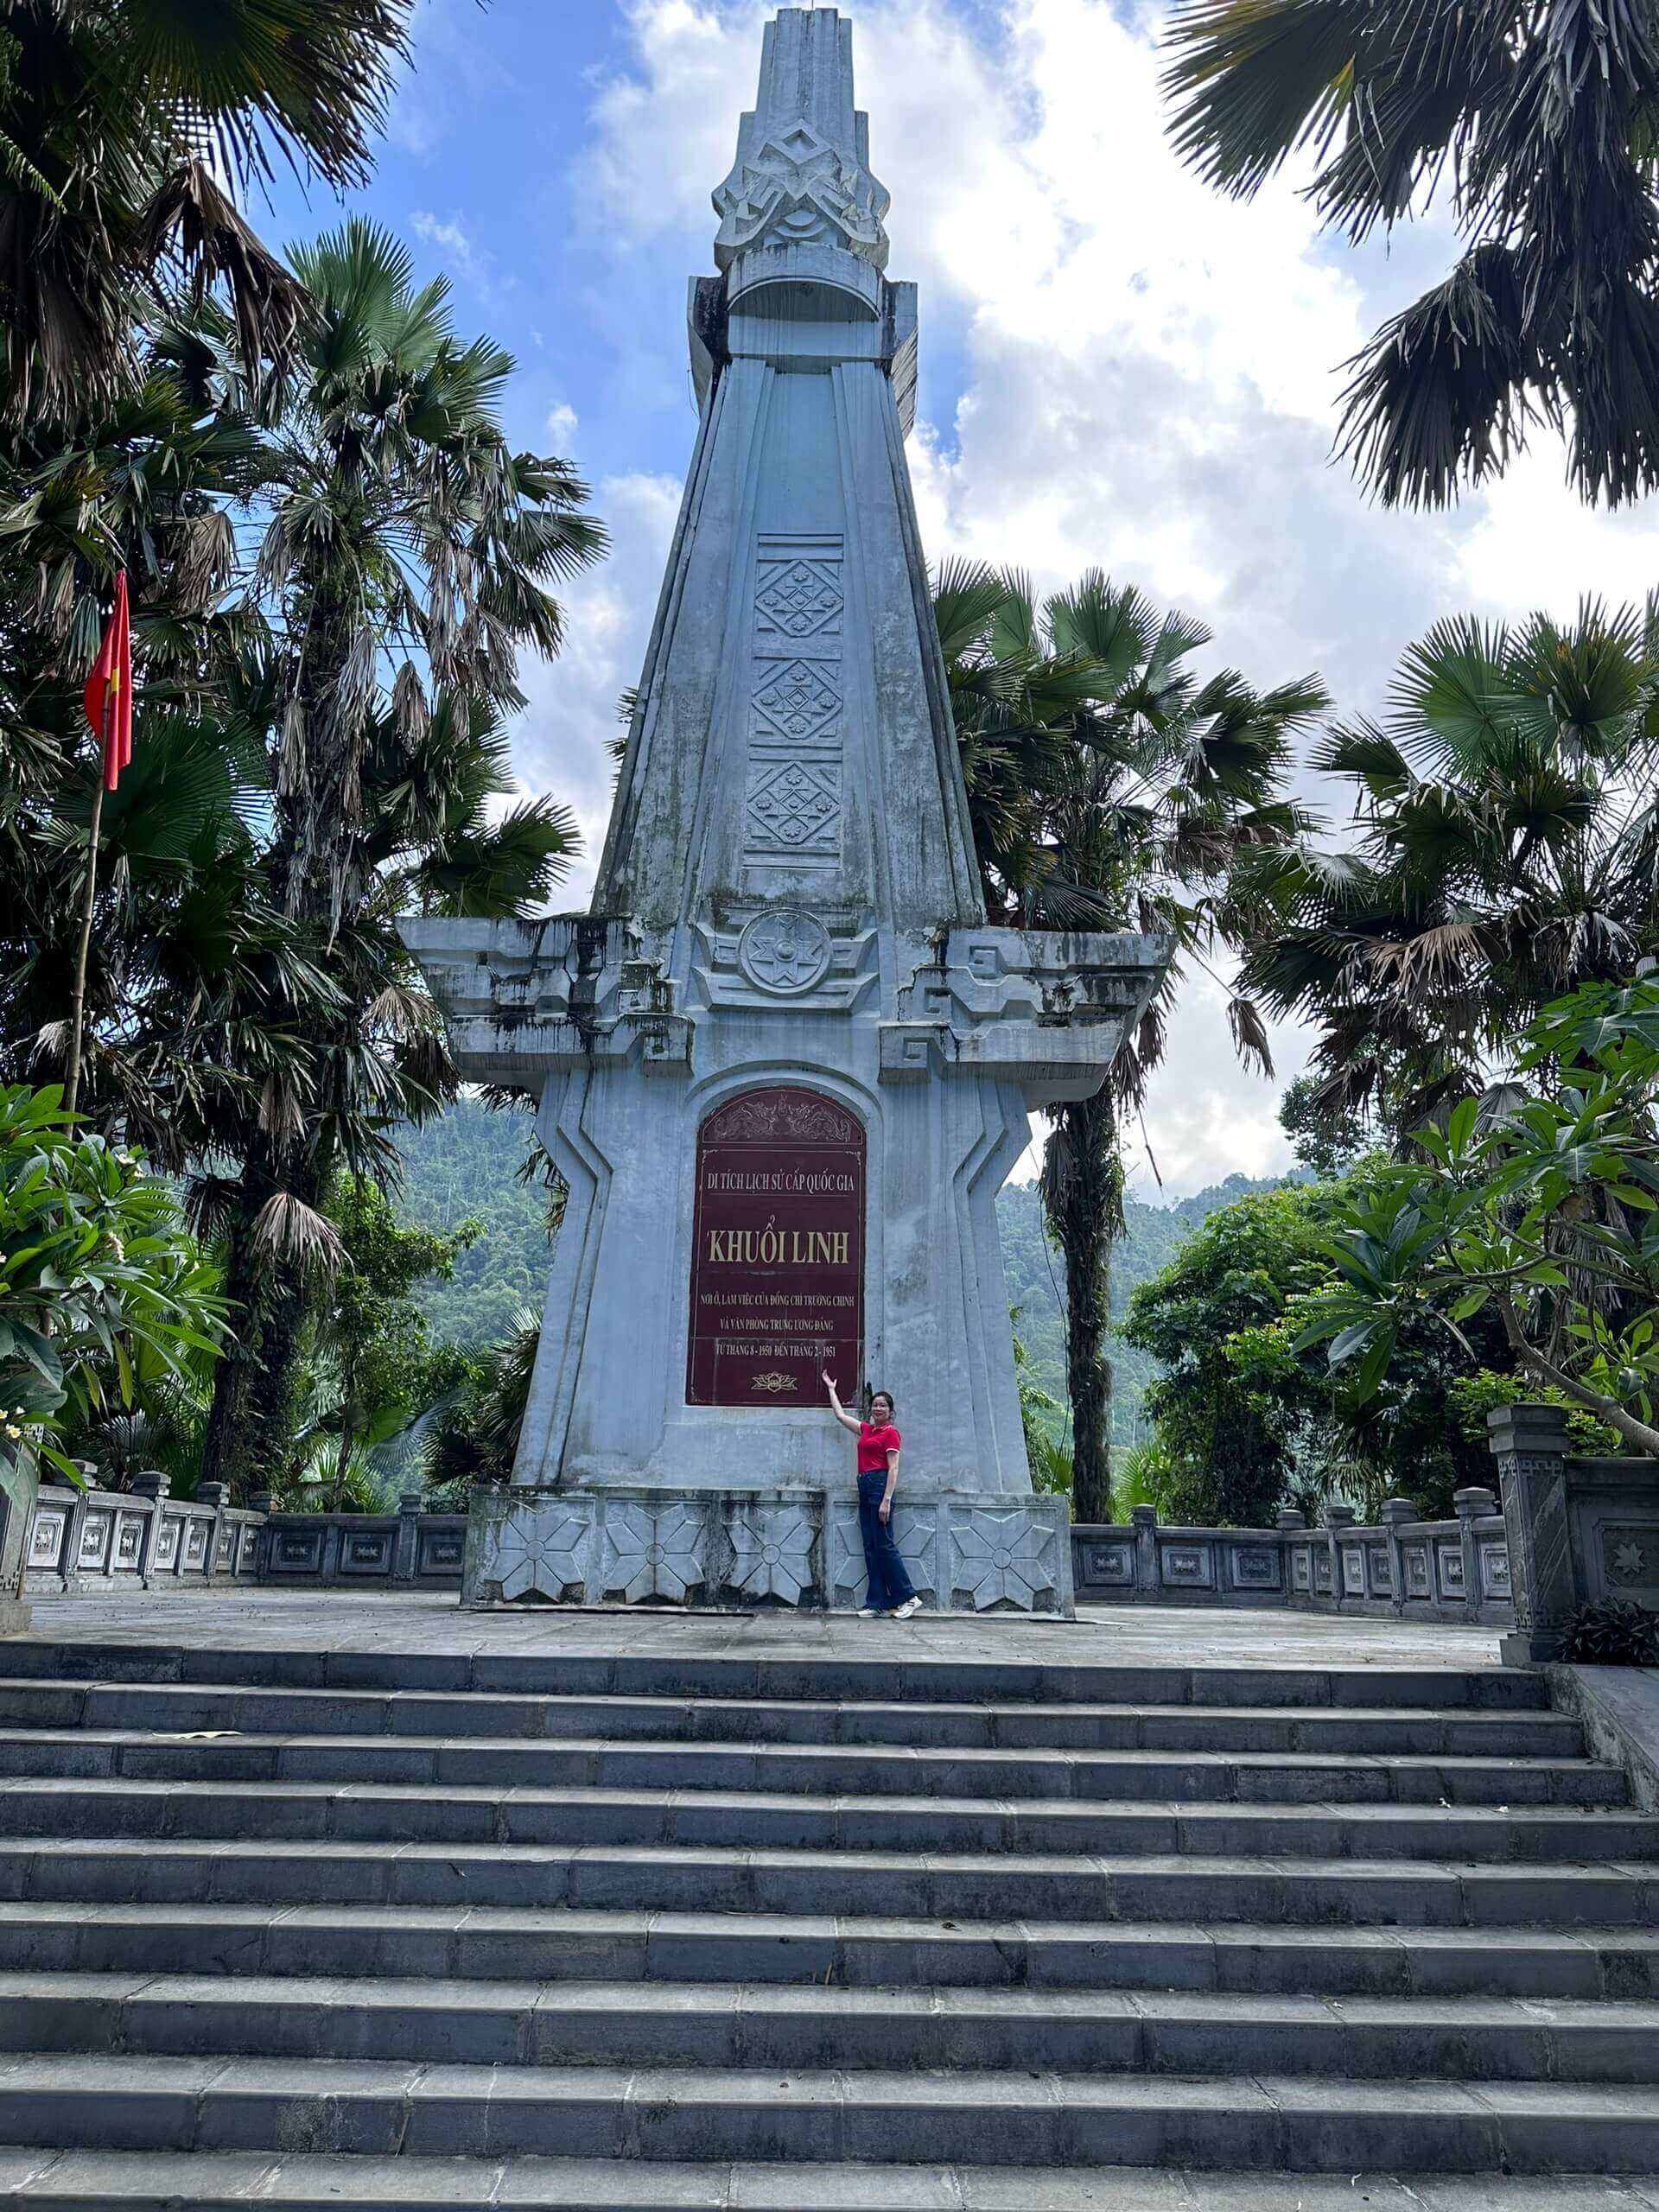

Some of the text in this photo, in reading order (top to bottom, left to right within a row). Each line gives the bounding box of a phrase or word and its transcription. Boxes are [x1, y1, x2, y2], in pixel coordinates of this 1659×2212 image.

[707, 1168, 854, 1194] DI TÍCH LỊCH SỬ CẤP QUỐC GIA
[709, 1215, 850, 1264] KHUỔI LINH
[770, 1319, 793, 1331] TRUNG
